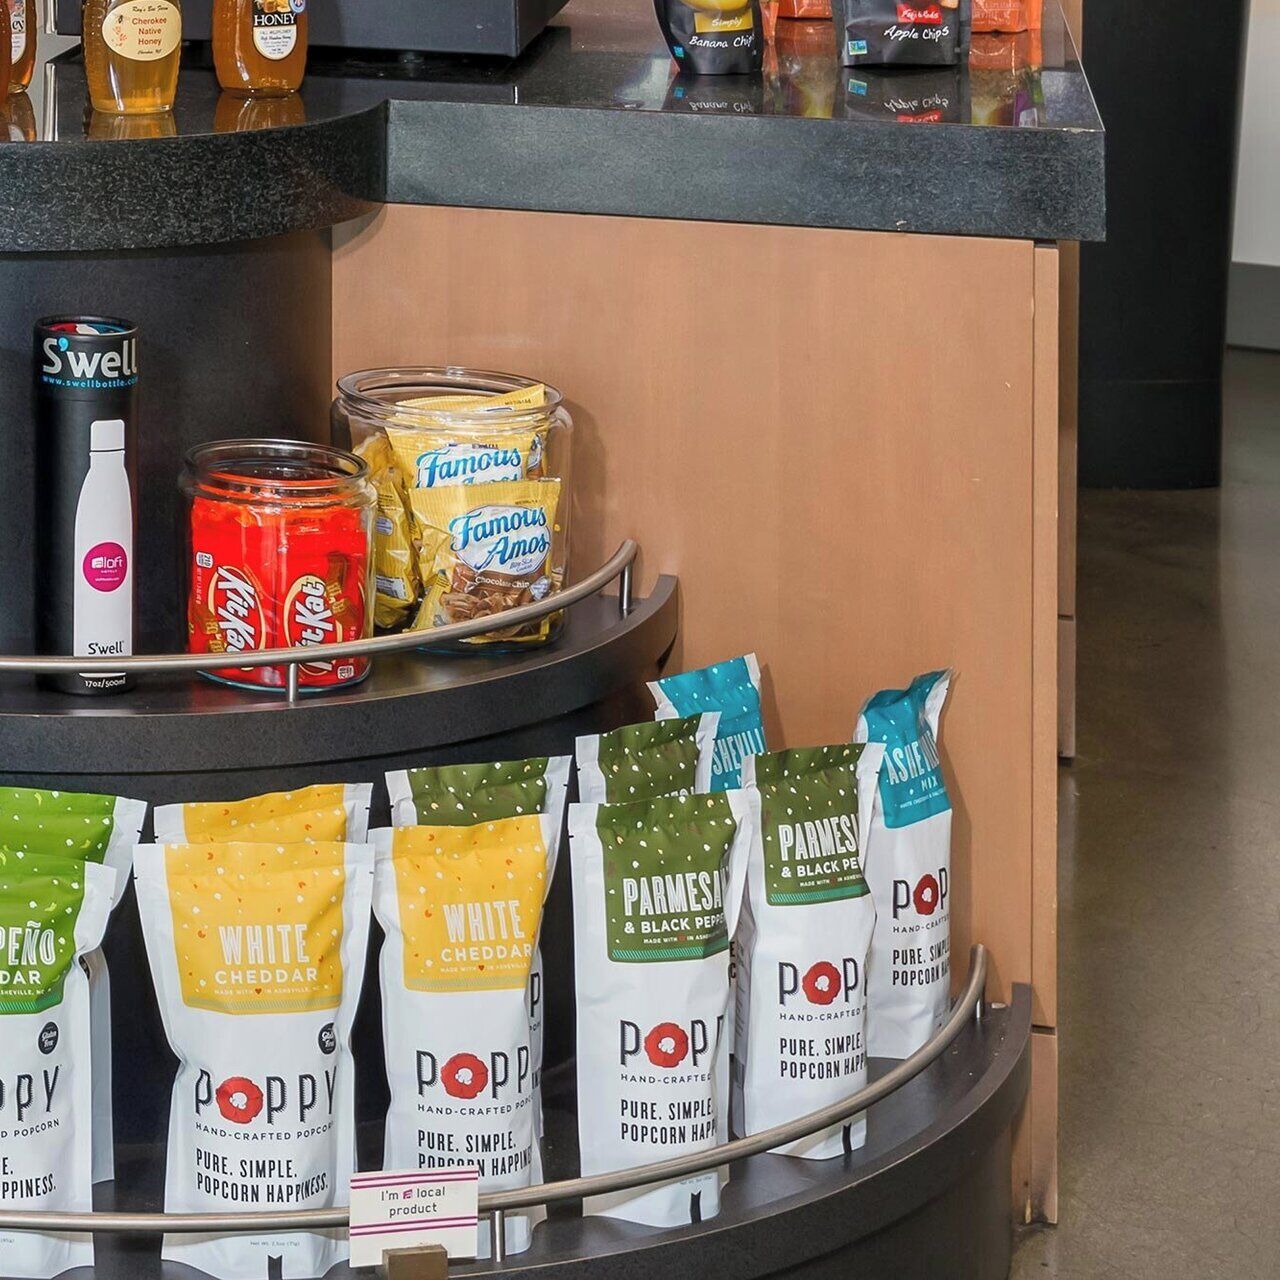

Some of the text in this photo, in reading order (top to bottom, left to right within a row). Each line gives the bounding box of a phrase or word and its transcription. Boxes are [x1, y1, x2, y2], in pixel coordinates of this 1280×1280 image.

[132, 17, 167, 26] Cherokee
[254, 12, 296, 26] HONEY
[711, 17, 743, 28] Simply
[689, 35, 729, 48] Banana
[883, 24, 949, 42] Apple Chips
[138, 38, 162, 46] Honey
[42, 336, 138, 378] S'well
[416, 448, 522, 489] Famous
[448, 506, 547, 552] Famous
[474, 534, 551, 570] Amos
[92, 555, 123, 570] aloft
[476, 576, 512, 588] Chocolate
[88, 641, 123, 655] S'well
[85, 677, 126, 689] 17oz/500ml
[921, 776, 938, 791] MIX
[781, 861, 840, 877] & BLACK
[443, 900, 525, 942] WHITE
[624, 918, 690, 933] & BLACK
[218, 923, 310, 965] WHITE
[441, 943, 532, 962] CHEDDAR
[893, 948, 926, 965] PURE.
[215, 967, 318, 984] CHEDDAR
[893, 965, 939, 985] POPCORN
[780, 1009, 861, 1021] HAND-CRAFTED
[780, 1032, 863, 1056] PURE. SIMPLE.
[780, 1060, 840, 1079] POPCORN
[621, 1073, 711, 1084] HAND-CRAFTED
[195, 1066, 337, 1125] POPPY
[417, 1102, 512, 1117] HAND-CRAFTED
[621, 1098, 713, 1120] PURE. SIMPLE.
[13, 1118, 60, 1138] POPCORN
[196, 1122, 291, 1141] HAND-CRAFTED
[621, 1123, 686, 1144] POPCORN
[418, 1130, 517, 1153] PURE. SIMPLE.
[197, 1148, 298, 1178] PURE. SIMPLE.
[197, 1172, 329, 1203] POPCORN HAPPINESS.
[381, 1186, 446, 1201] I'm local
[389, 1202, 438, 1218] product
